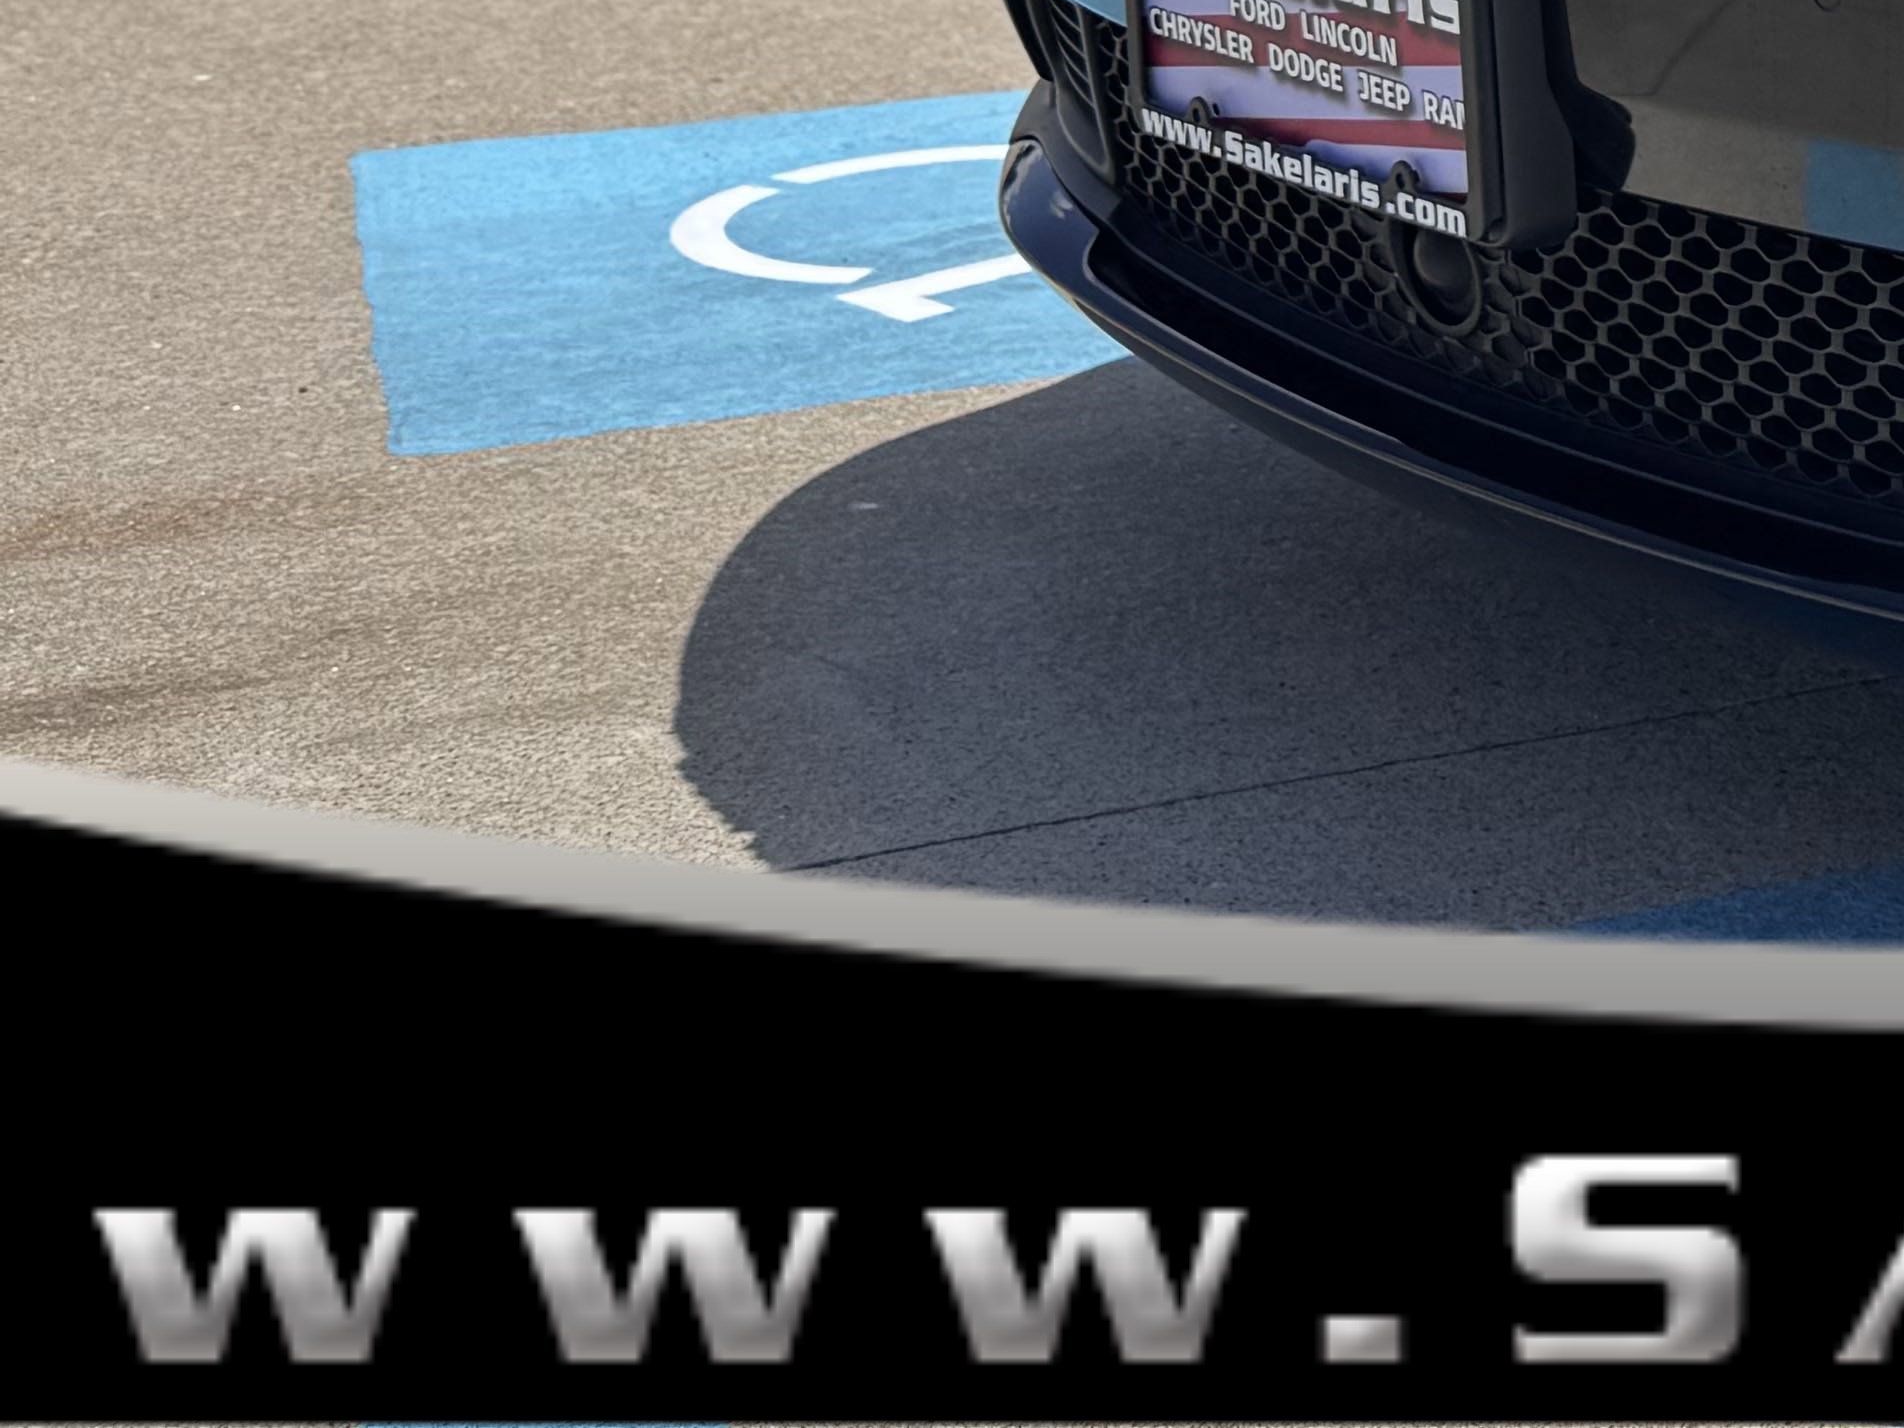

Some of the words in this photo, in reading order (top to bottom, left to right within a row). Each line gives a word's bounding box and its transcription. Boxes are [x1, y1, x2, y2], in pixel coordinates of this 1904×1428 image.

[1149, 7, 1254, 64] CHRYSLER
[1268, 42, 1344, 93] DODGE
[1357, 71, 1411, 114] JEEP
[1300, 11, 1397, 67] LINCOLN
